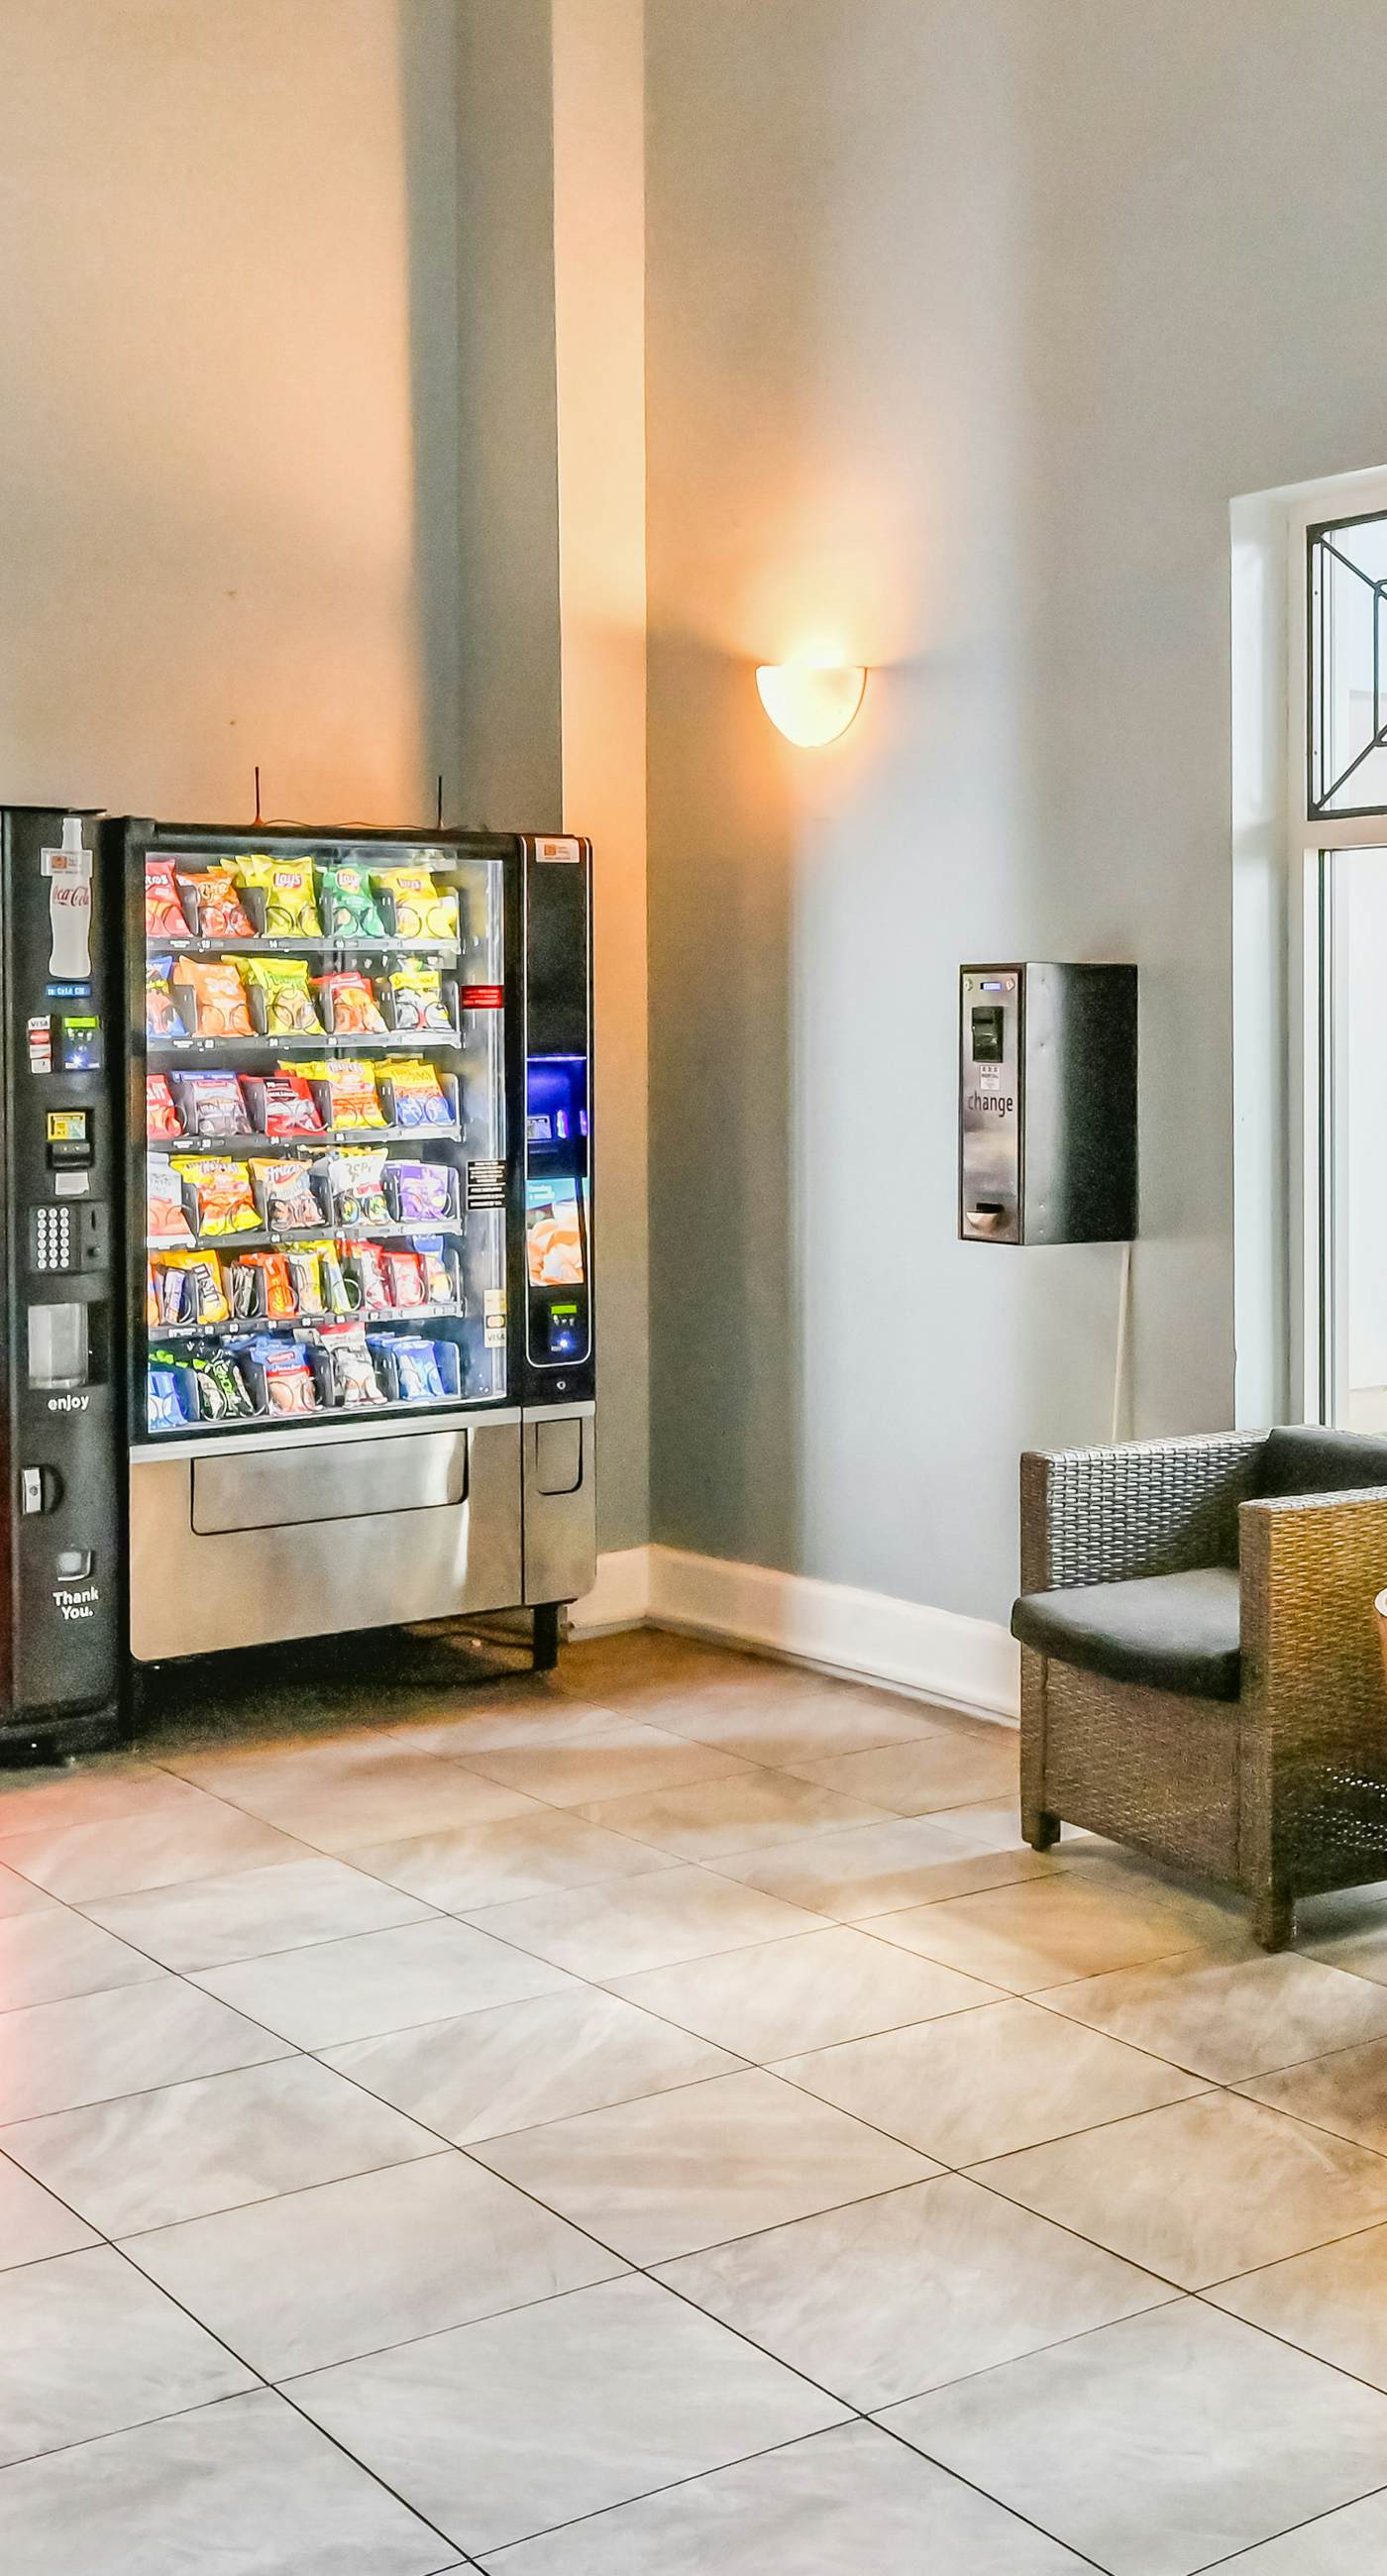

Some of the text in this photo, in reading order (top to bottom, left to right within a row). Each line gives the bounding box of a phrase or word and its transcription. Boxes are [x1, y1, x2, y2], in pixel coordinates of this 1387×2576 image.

[968, 1091, 1014, 1118] change
[486, 1332, 505, 1342] VISA
[48, 1394, 89, 1412] enjoy
[53, 1585, 99, 1607] Thank
[61, 1605, 94, 1621] You.
